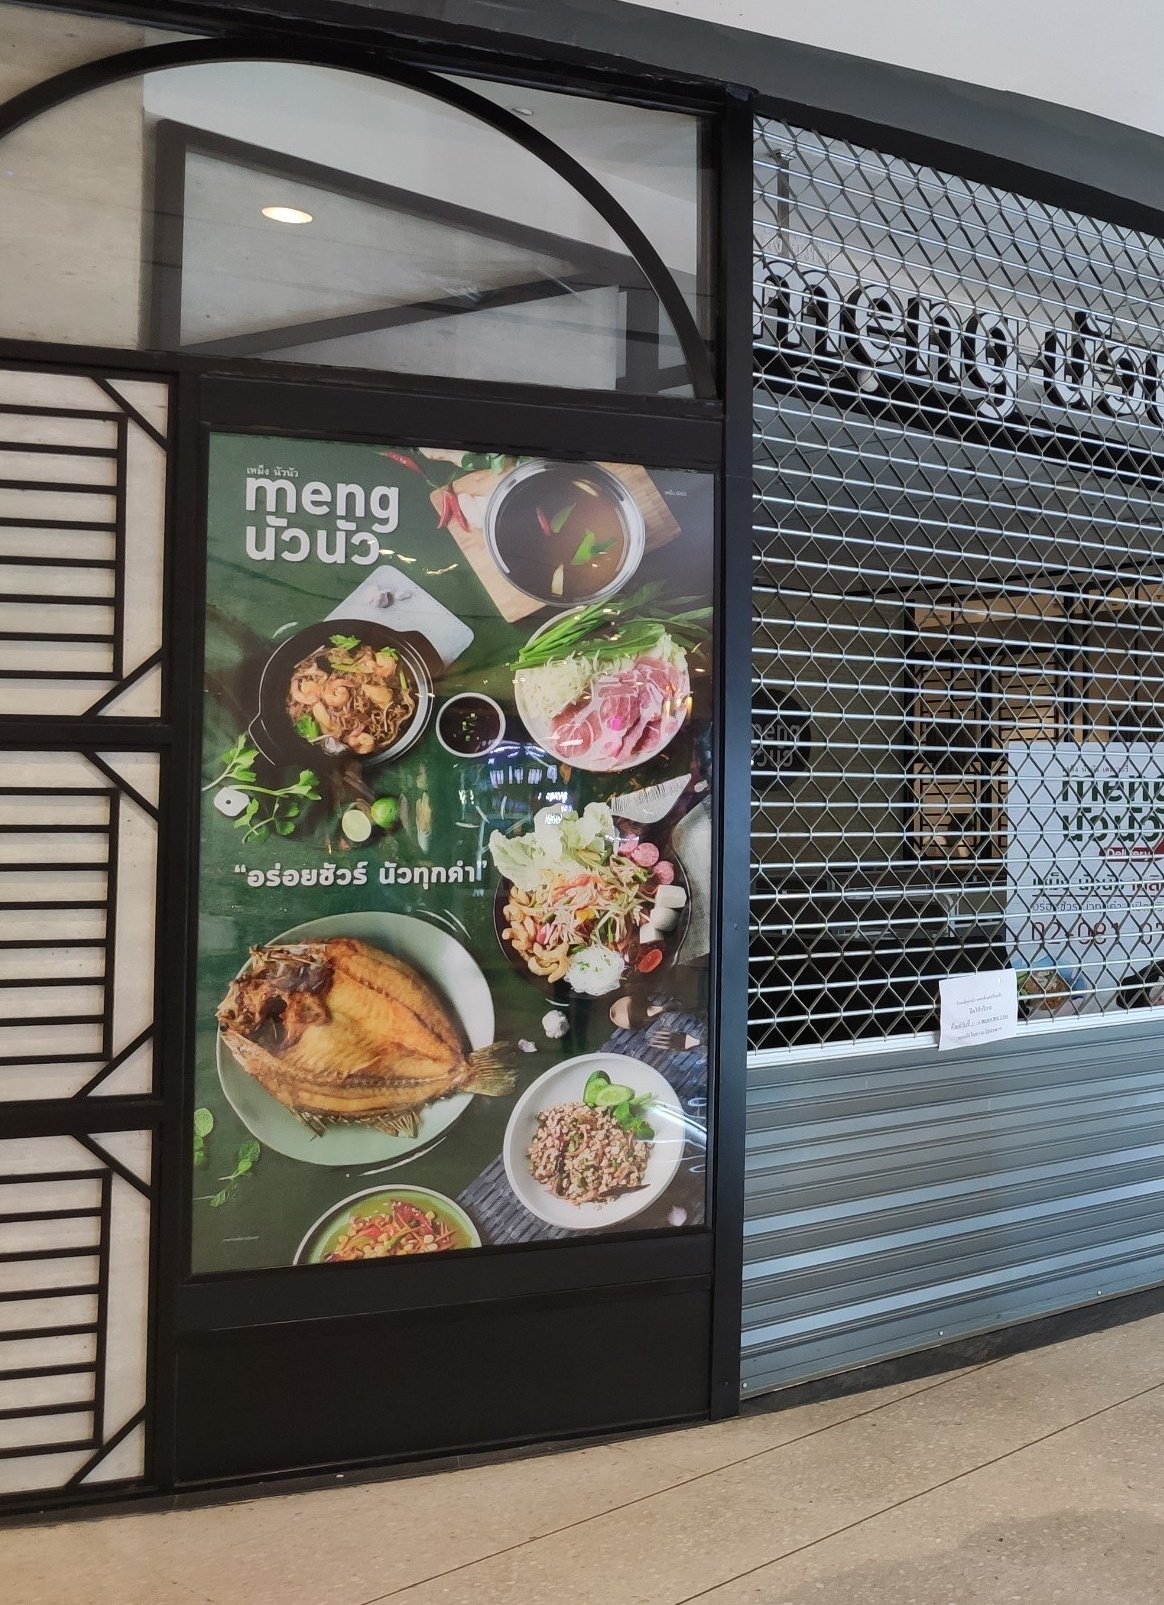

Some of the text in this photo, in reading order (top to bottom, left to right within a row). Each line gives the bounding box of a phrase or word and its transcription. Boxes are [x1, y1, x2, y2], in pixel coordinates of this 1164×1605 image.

[753, 254, 1019, 419] meng
[246, 465, 270, 476] เหม็ง
[246, 477, 399, 533] meng
[246, 515, 379, 566] นัวนัว
